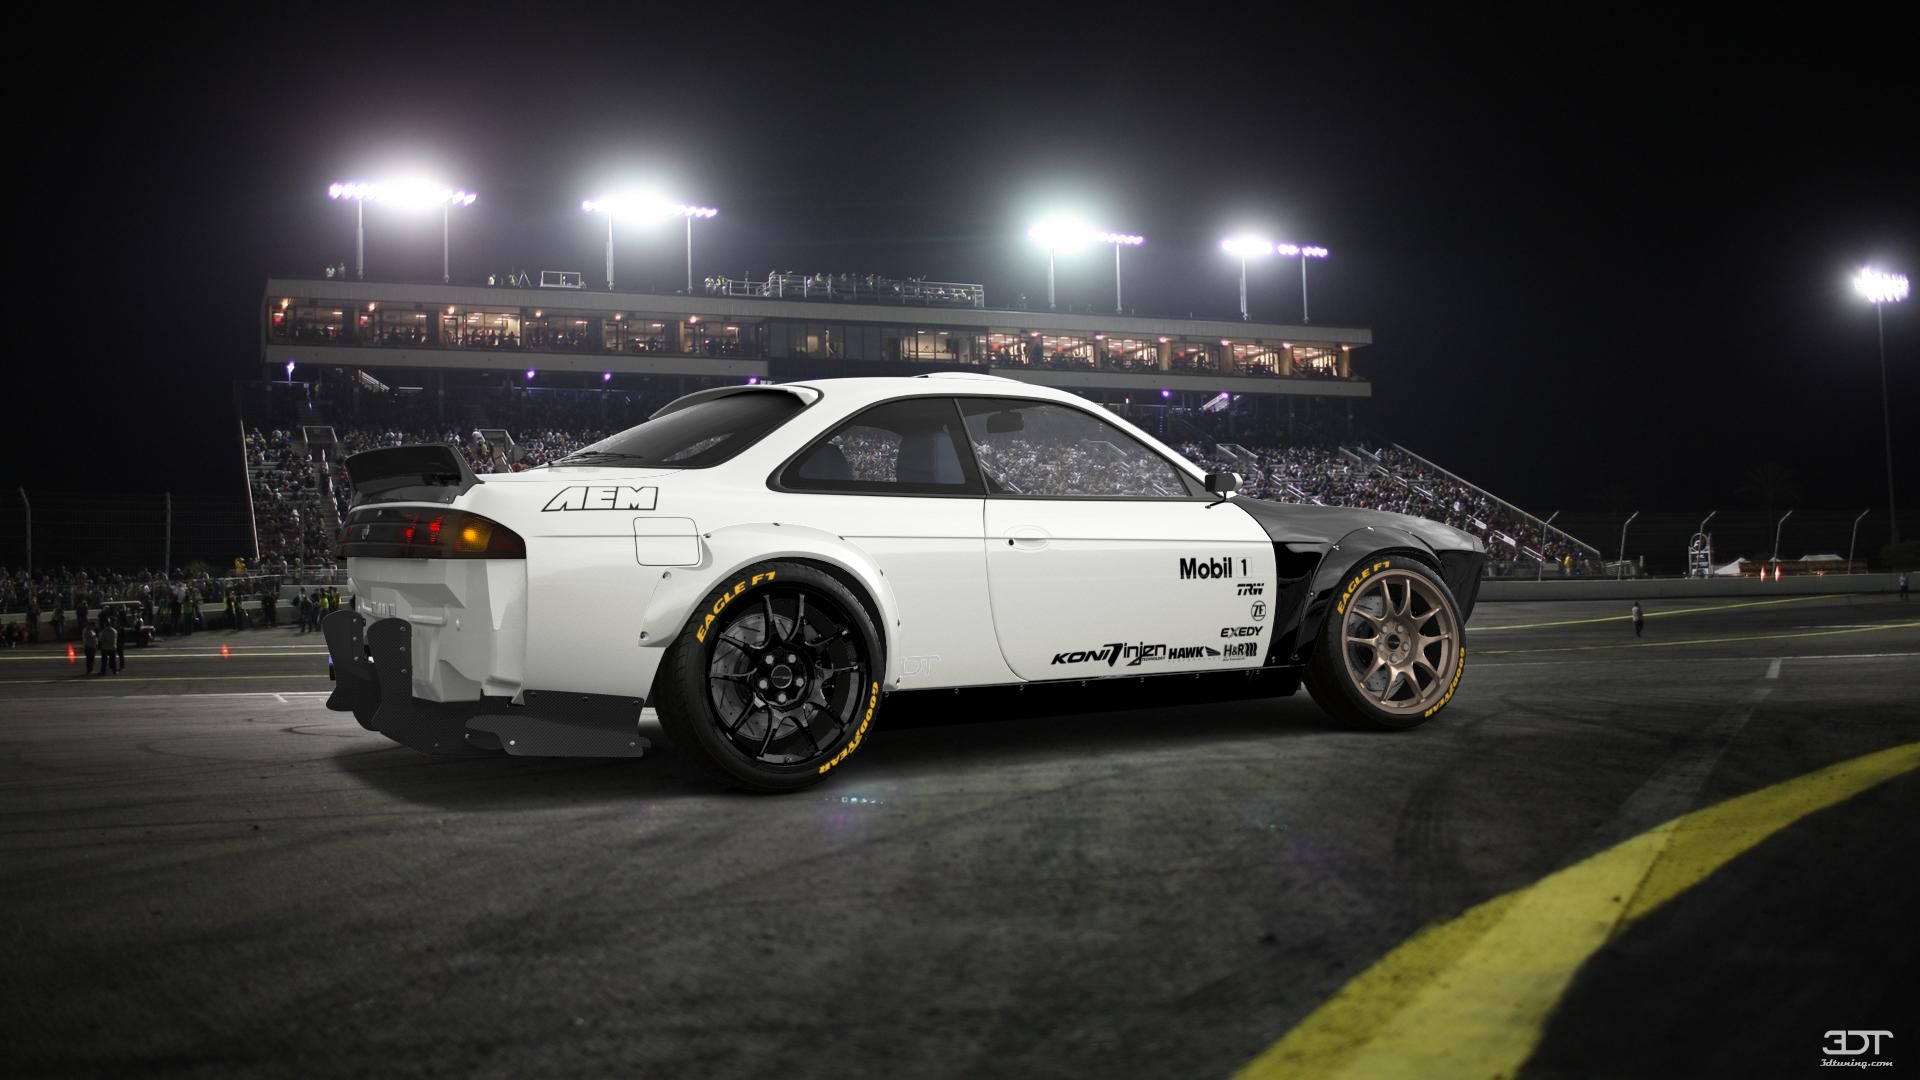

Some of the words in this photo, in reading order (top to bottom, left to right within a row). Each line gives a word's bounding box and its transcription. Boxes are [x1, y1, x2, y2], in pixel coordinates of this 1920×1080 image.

[541, 486, 659, 512] AEM
[1180, 557, 1232, 579] Mobil
[1241, 558, 1247, 576] 1
[1237, 583, 1265, 596] TRW
[1337, 567, 1371, 615] EAGLE
[1373, 561, 1390, 572] F1
[696, 581, 746, 644] EAGLE
[751, 571, 776, 586] F1
[1251, 602, 1266, 619] ZF
[1220, 625, 1264, 638] EXEDY
[1123, 641, 1167, 666] injen
[1168, 646, 1205, 660] HAWK
[1223, 643, 1247, 657] H&R
